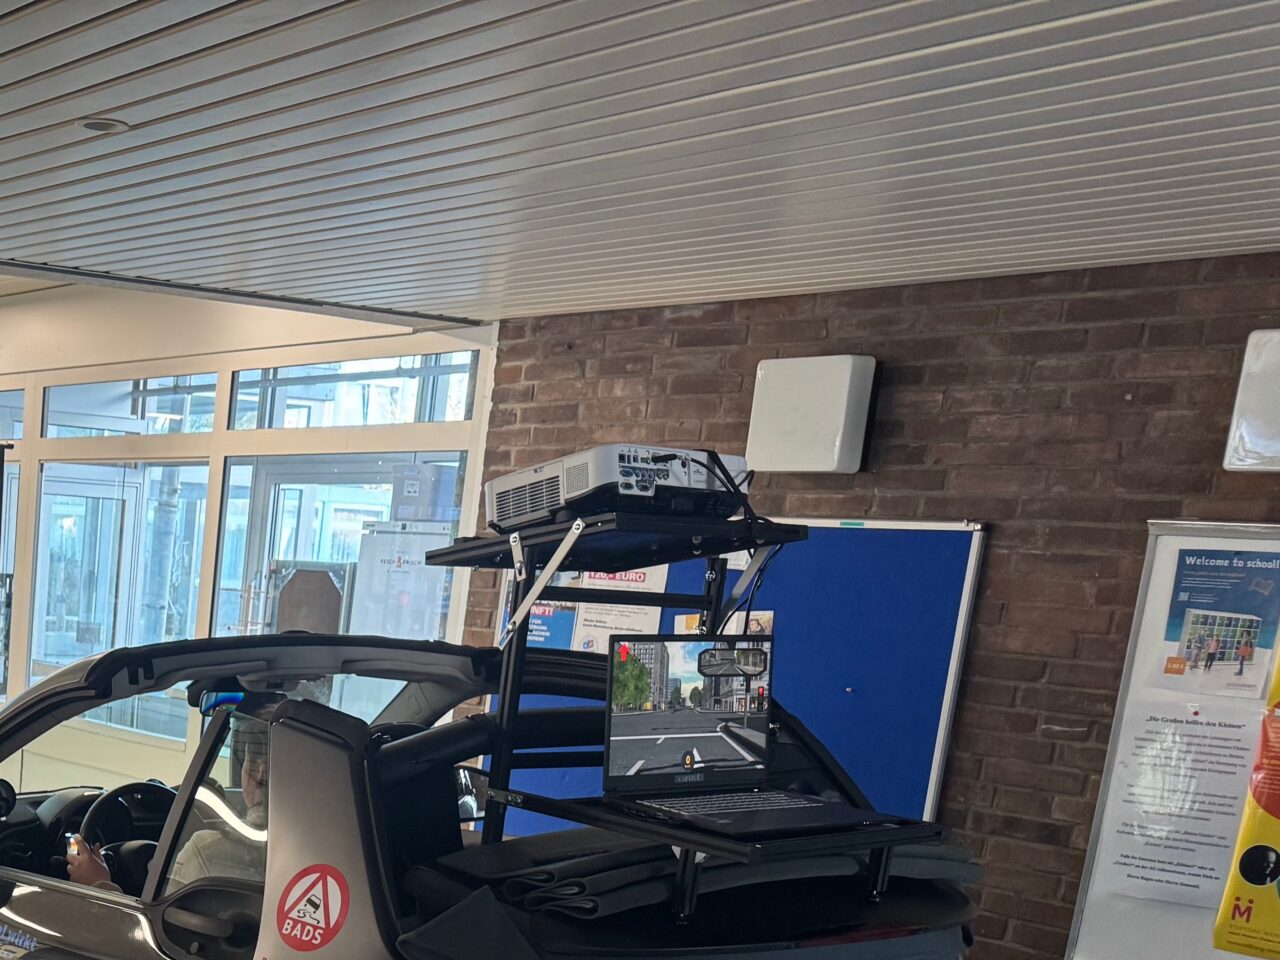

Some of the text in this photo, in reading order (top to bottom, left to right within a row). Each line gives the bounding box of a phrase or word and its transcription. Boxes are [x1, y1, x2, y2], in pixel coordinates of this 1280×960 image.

[1185, 556, 1280, 569] Welcome to school!
[615, 571, 645, 582] EURO
[282, 919, 324, 944] BADS
